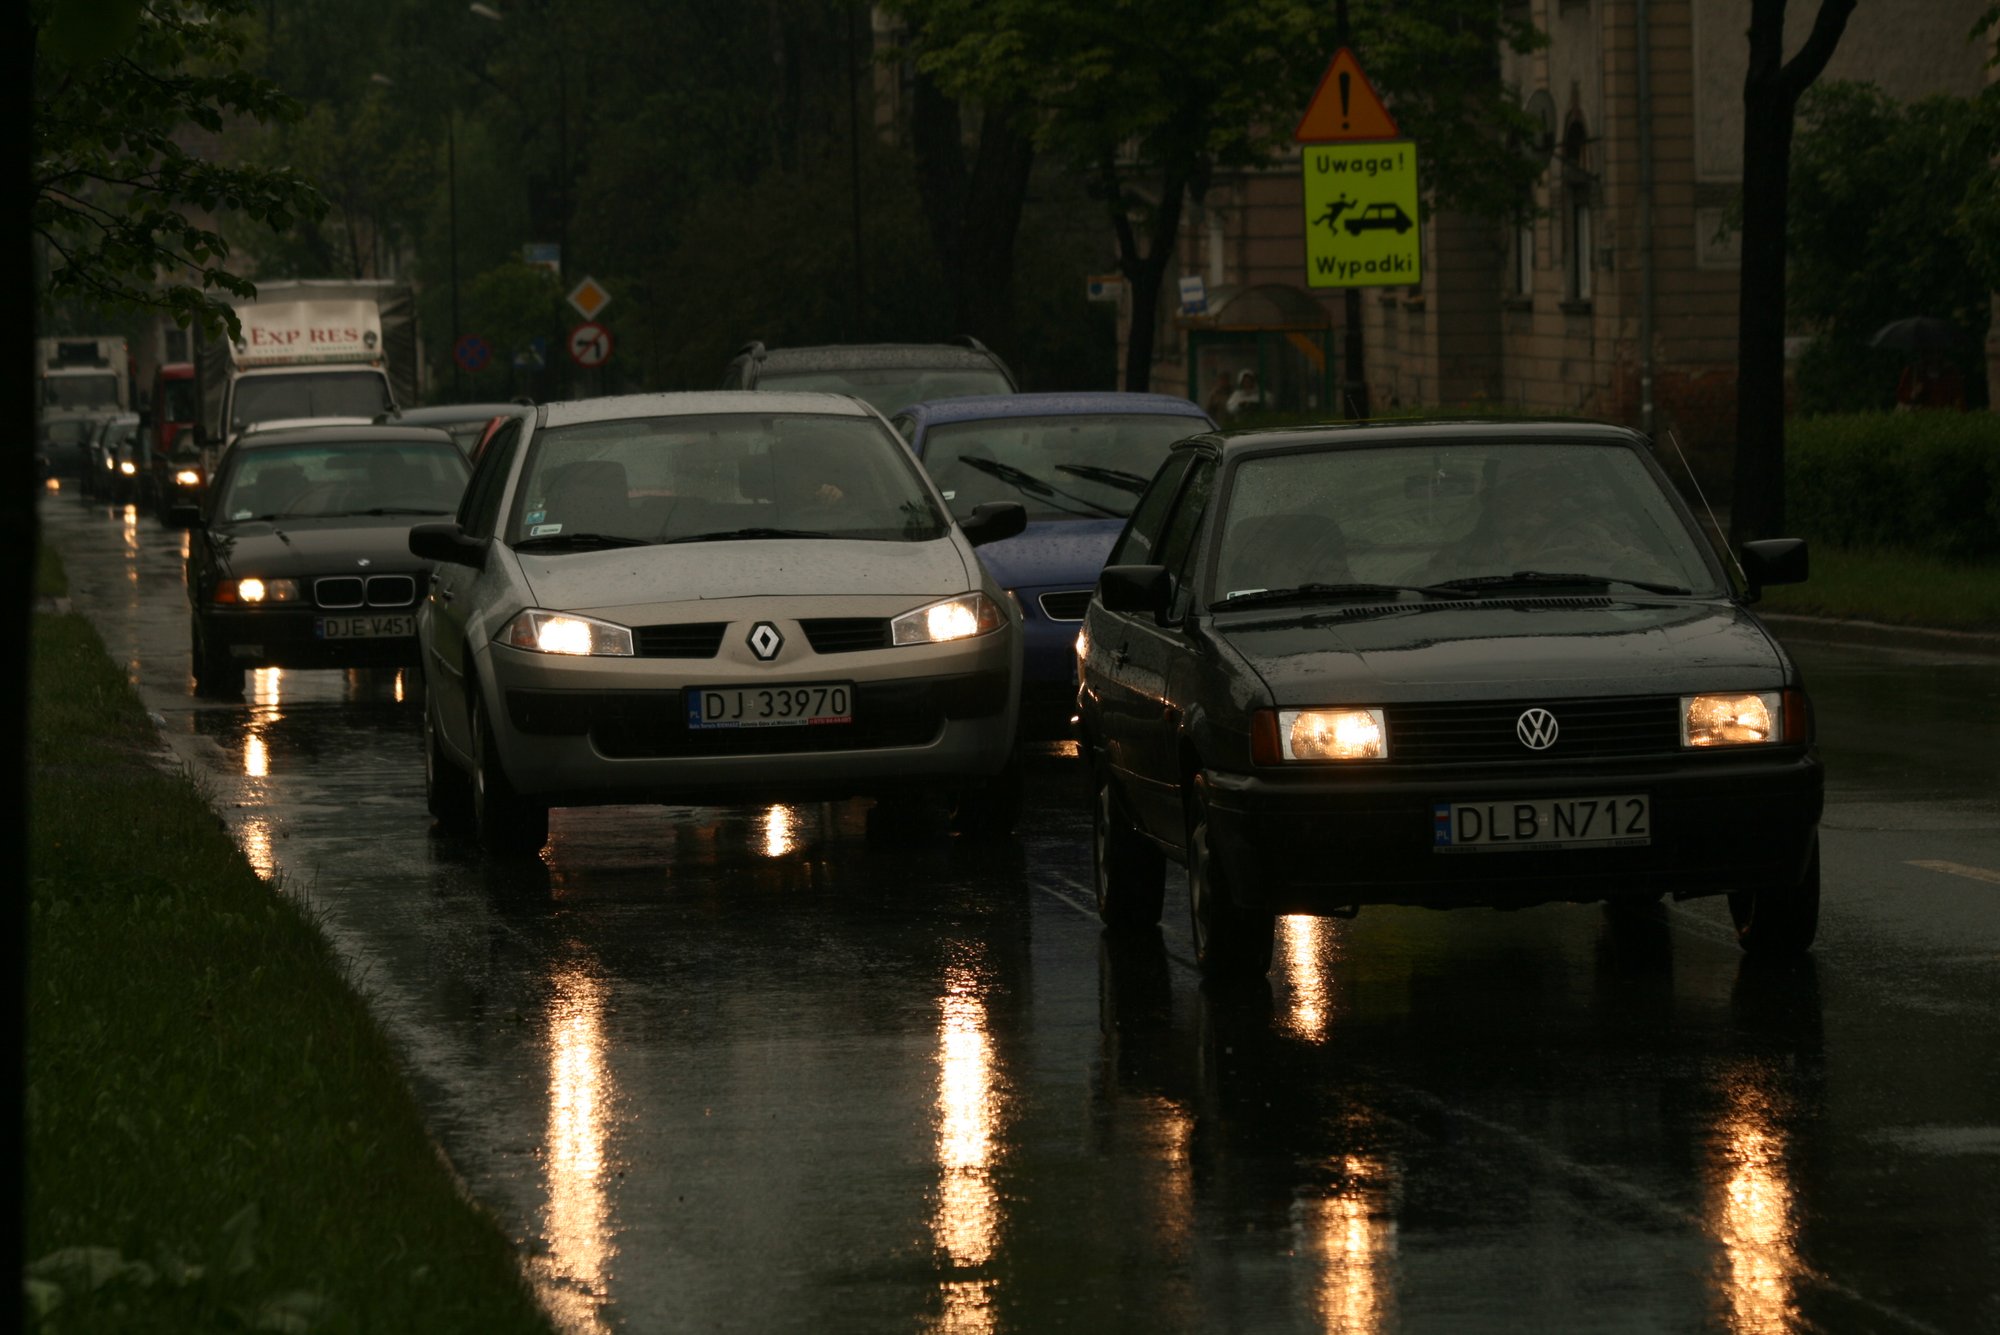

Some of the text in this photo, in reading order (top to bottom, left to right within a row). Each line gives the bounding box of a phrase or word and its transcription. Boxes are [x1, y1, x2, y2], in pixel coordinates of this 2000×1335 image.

[1316, 253, 1412, 279] Wypadki
[326, 618, 412, 636] DJE V451
[706, 688, 846, 719] DJ 33970
[1457, 798, 1646, 842] DLB N712
[1436, 829, 1449, 840] PL
